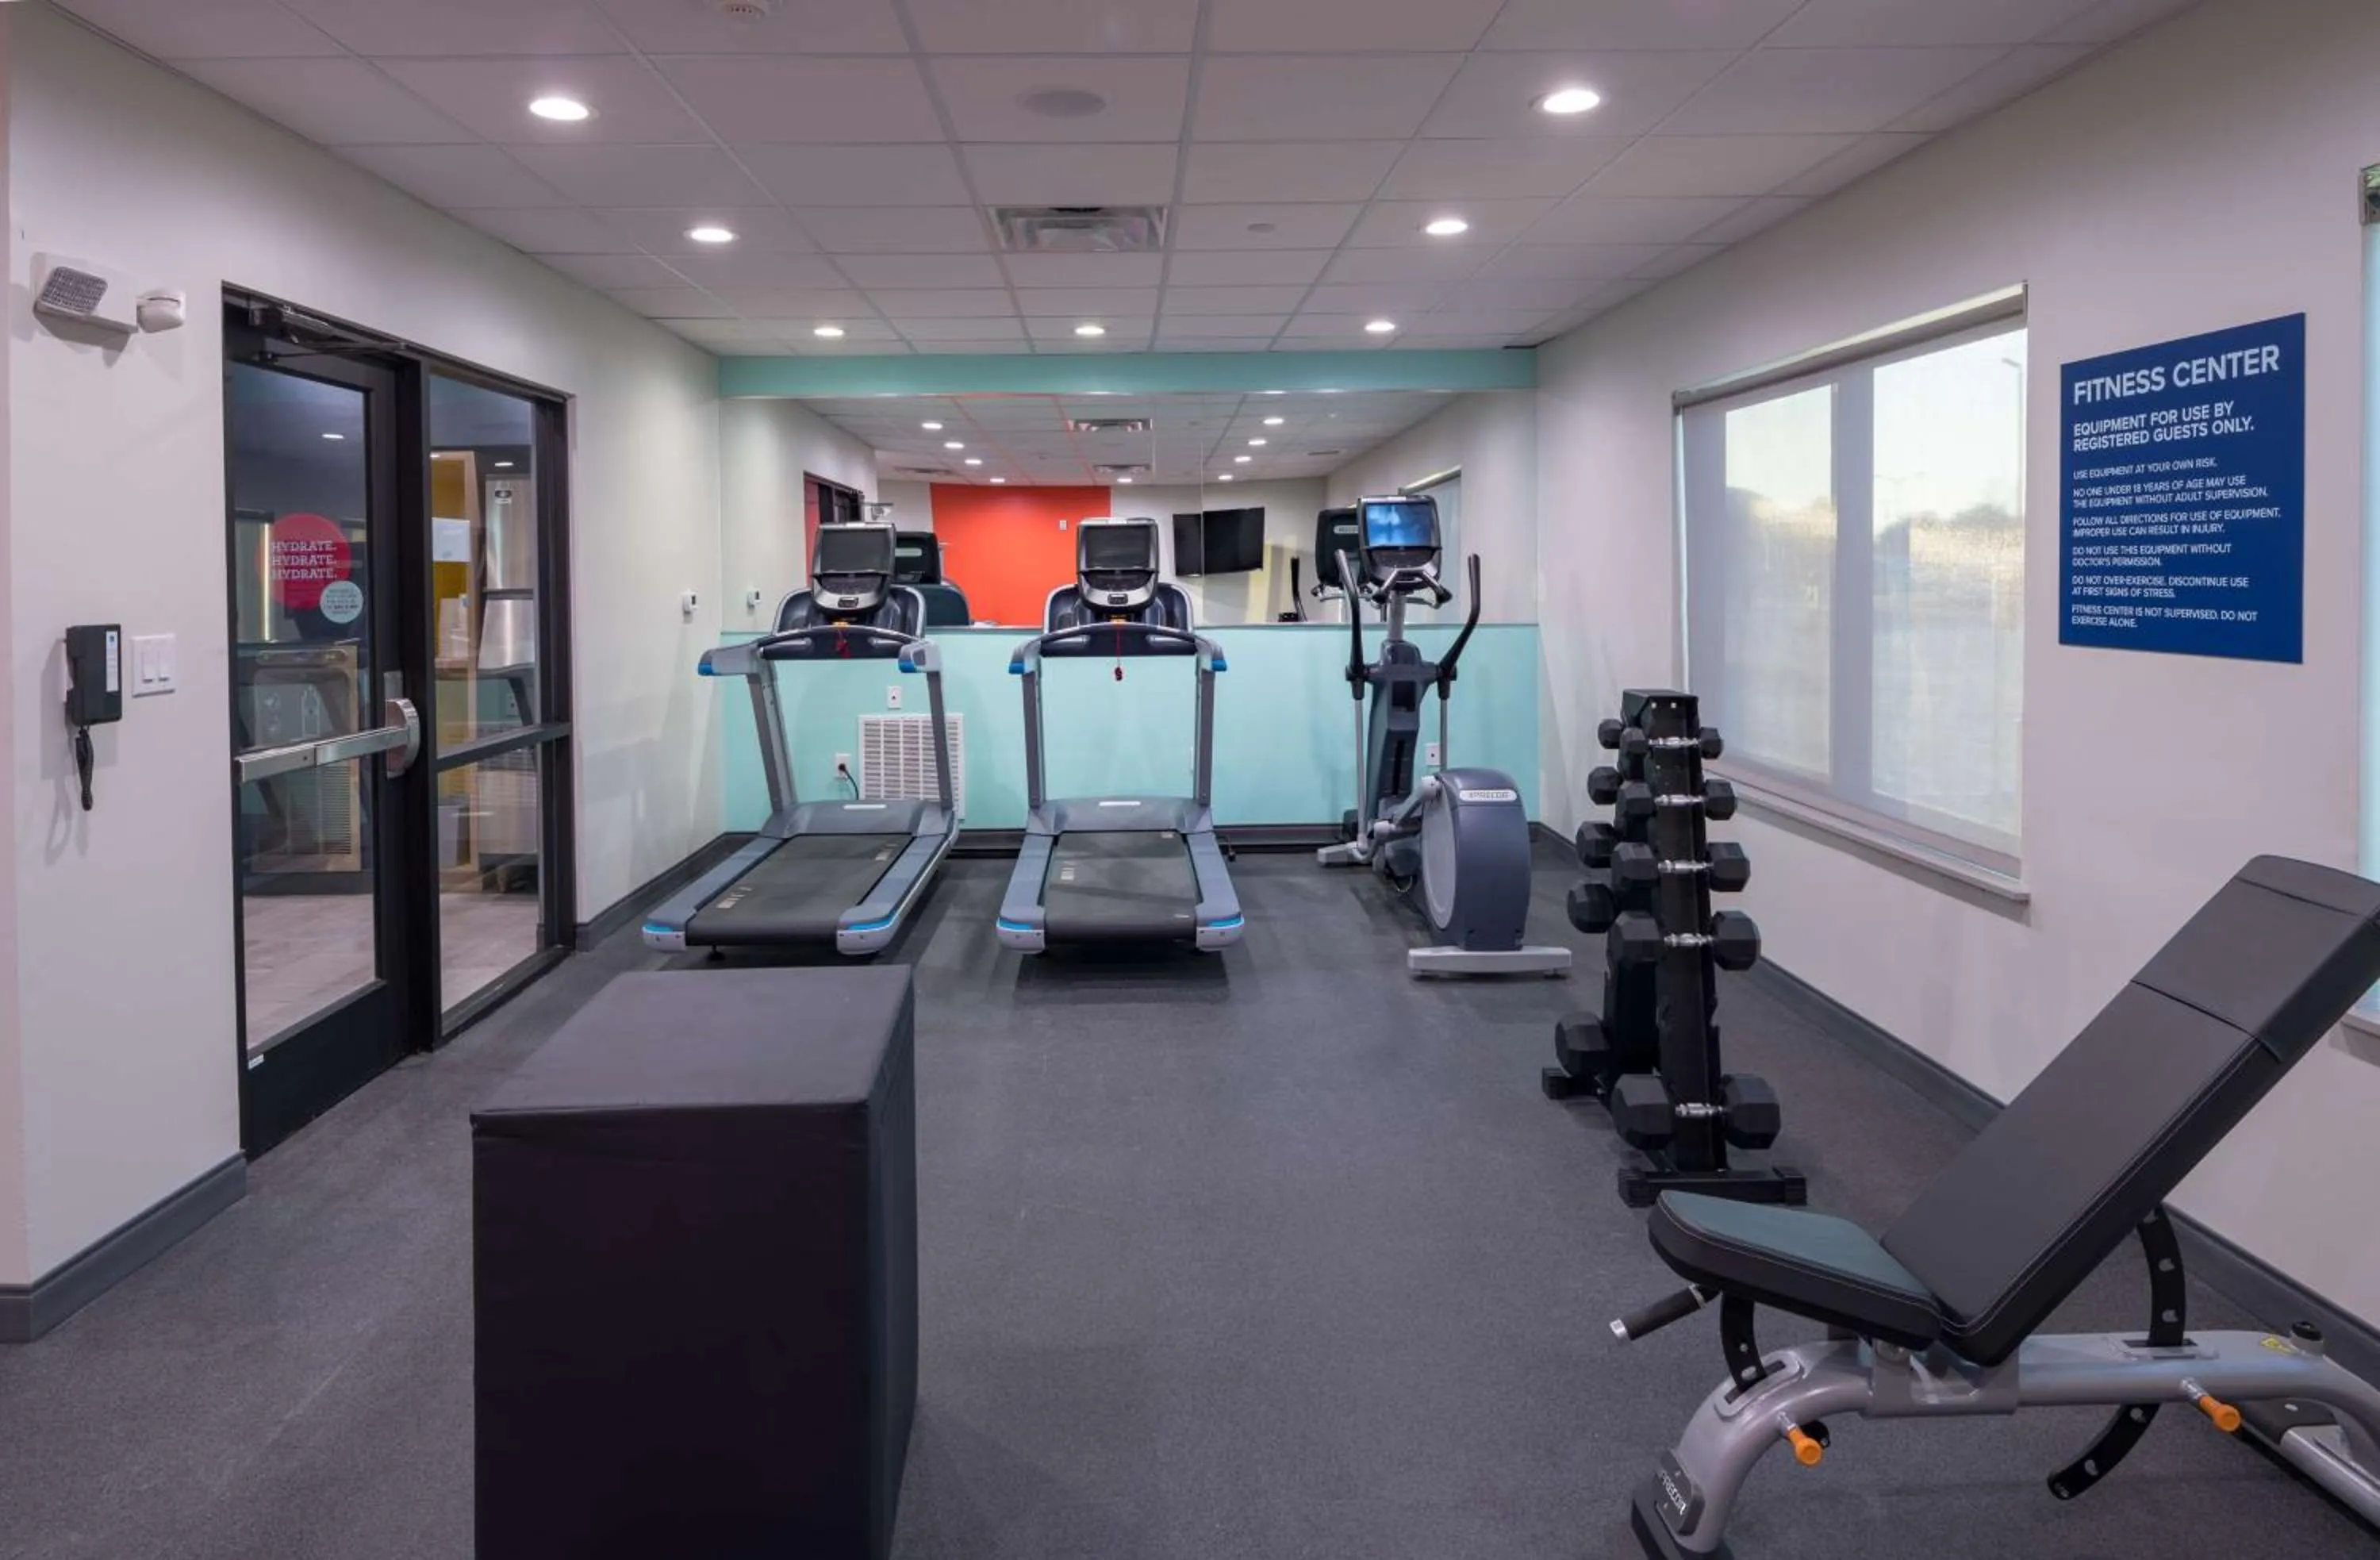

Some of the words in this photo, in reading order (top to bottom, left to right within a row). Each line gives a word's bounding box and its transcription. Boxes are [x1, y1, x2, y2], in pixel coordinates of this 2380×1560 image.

[2074, 366, 2166, 405] FITNESS
[2172, 344, 2280, 387] CENTER
[2074, 413, 2148, 437] EQUIPMENT
[2150, 409, 2178, 426] FOR
[2182, 405, 2209, 421] USE
[2214, 400, 2234, 417] BY
[2074, 429, 2149, 451] REGISTERED
[2153, 422, 2209, 442] GUESTS
[2212, 415, 2255, 435] ONLY.
[2073, 469, 2088, 480] USE
[2089, 464, 2133, 478] EQUIPMENT
[2135, 463, 2145, 474] AT
[2148, 461, 2171, 472] YOUR
[2172, 459, 2194, 471] OWN
[2195, 456, 2218, 468] RISK.
[2073, 487, 2086, 498] NO
[2086, 486, 2103, 497] ONE
[2104, 484, 2132, 496] UNDER
[2144, 481, 2170, 492] YEARS
[2171, 479, 2184, 490] OF
[2186, 478, 2205, 489] AGE
[2205, 476, 2225, 487] MAY
[2227, 475, 2247, 486] USE
[2073, 499, 2087, 509] THE
[2089, 496, 2133, 508] EQUIPMENT
[2135, 493, 2173, 505] WITHOUT
[2175, 491, 2202, 502] ADULT
[2205, 486, 2269, 501] SUPERVISION.
[2072, 516, 2103, 526] FOLLOW
[2105, 515, 2118, 525] ALL
[2119, 513, 2168, 524] DIRECTIONS
[2170, 511, 2188, 523] FOR
[2190, 510, 2208, 522] USE
[2209, 510, 2222, 521] OF
[2224, 507, 2282, 521] EQUIPMENT.
[2072, 527, 2110, 537] IMPROPER
[2111, 526, 2128, 536] USE
[2129, 525, 2148, 536] CAN
[2148, 524, 2178, 535] RESULT
[2181, 524, 2190, 534] IN
[2192, 523, 2226, 534] INJURY.
[271, 540, 337, 553] HYDRATE.
[2072, 546, 2085, 555] DO
[2086, 545, 2102, 555] NOT
[2103, 545, 2119, 555] USE
[2120, 545, 2138, 555] THIS
[2140, 544, 2188, 555] EQUIPMENT
[2190, 543, 2232, 554] WITHOUT
[271, 554, 337, 567] HYDRATE.
[270, 567, 337, 581] HYDRATE.
[2072, 575, 2084, 586] DO
[2085, 575, 2102, 586] NOT
[2168, 576, 2228, 587] DISCONTINUE
[2230, 577, 2250, 588] USE
[2071, 587, 2082, 597] AT
[2082, 587, 2103, 597] FIRST
[2105, 587, 2129, 597] SIGNS
[2130, 588, 2142, 597] OF
[2143, 588, 2175, 598] STRESS.
[2071, 604, 2102, 615] FITNESS
[2103, 605, 2134, 616] CENTER
[2136, 606, 2143, 617] IS
[2144, 607, 2163, 617] NOT
[2221, 609, 2236, 621] DO
[2237, 610, 2259, 622] NOT
[2071, 615, 2108, 627] EXERCISE
